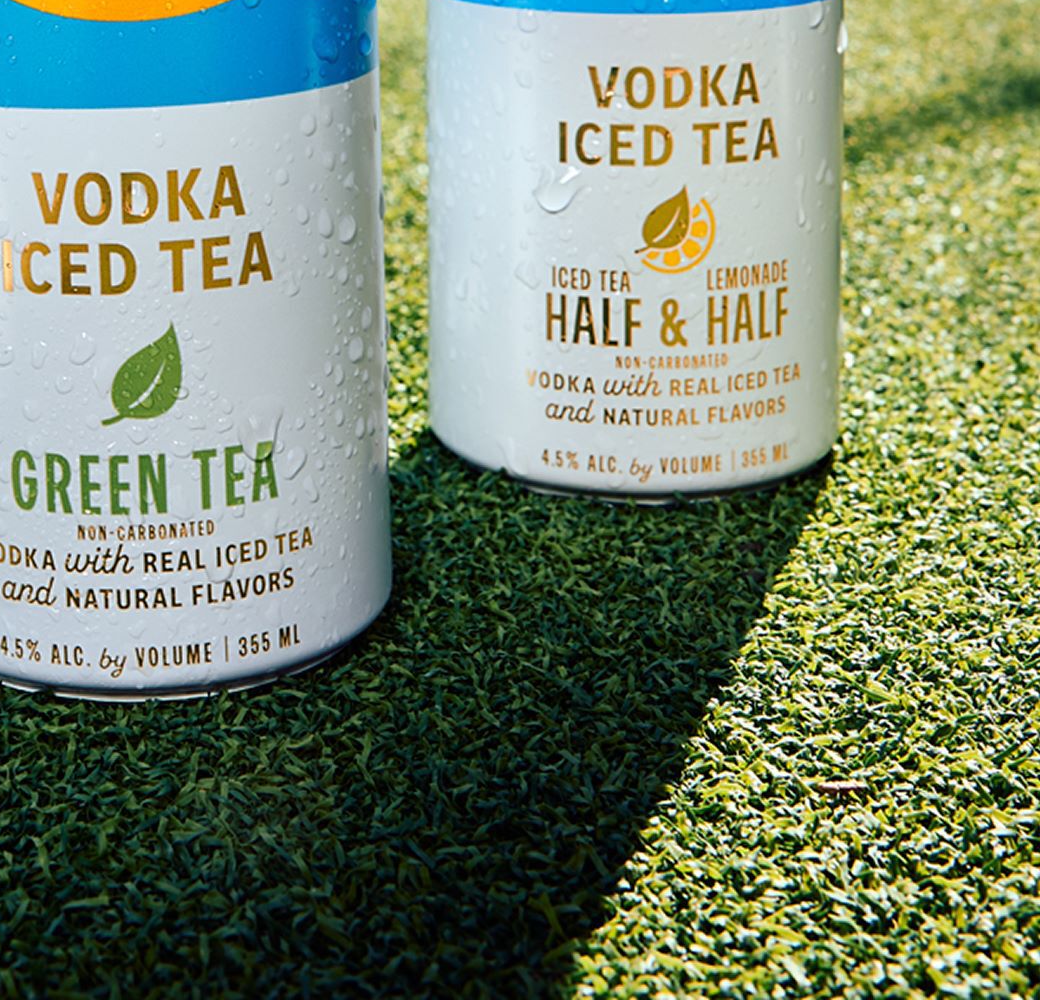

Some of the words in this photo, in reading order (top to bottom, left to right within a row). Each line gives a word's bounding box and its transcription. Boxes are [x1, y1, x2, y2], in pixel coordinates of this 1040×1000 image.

[587, 62, 760, 109] VODKA
[558, 120, 674, 167] ICED
[692, 117, 780, 165] TEA
[31, 164, 247, 226] VODKA
[1, 238, 138, 296] ICED
[159, 231, 273, 293] TEA
[551, 265, 591, 290] ICED
[599, 269, 632, 293] TEA
[706, 259, 789, 291] LEMONADE
[545, 292, 642, 347] HALF
[660, 298, 688, 347] &
[707, 286, 789, 346] HALF
[526, 368, 596, 394] VODKA
[603, 372, 662, 397] with
[669, 378, 720, 397] REAL
[727, 370, 767, 393] ICED
[773, 362, 801, 385] TEA
[615, 353, 729, 370] NON-CARBONATED
[545, 398, 596, 424] and
[603, 407, 700, 426] NATURAL
[707, 395, 787, 425] FLAVORS
[11, 449, 168, 516] GREEN
[192, 440, 279, 510] TEA
[541, 449, 580, 470] 4.5%
[587, 454, 622, 474] ALC.
[629, 457, 653, 483] by
[660, 453, 722, 475] VOLUME
[741, 446, 767, 467] 355
[772, 441, 789, 462] ML
[65, 544, 134, 575] with
[143, 549, 206, 574] REAL
[216, 538, 268, 568] ICED
[274, 525, 314, 557] TEA
[77, 520, 215, 541] NON-CARBONATED
[1, 577, 57, 607] and
[66, 586, 183, 610] NATURAL
[192, 567, 295, 606] FLAVORS
[0, 635, 41, 663] 4.5%
[51, 643, 91, 668] ALC.
[99, 645, 128, 677] by
[135, 642, 213, 668] VOLUME
[239, 631, 271, 659] 355
[279, 623, 301, 649] ML
